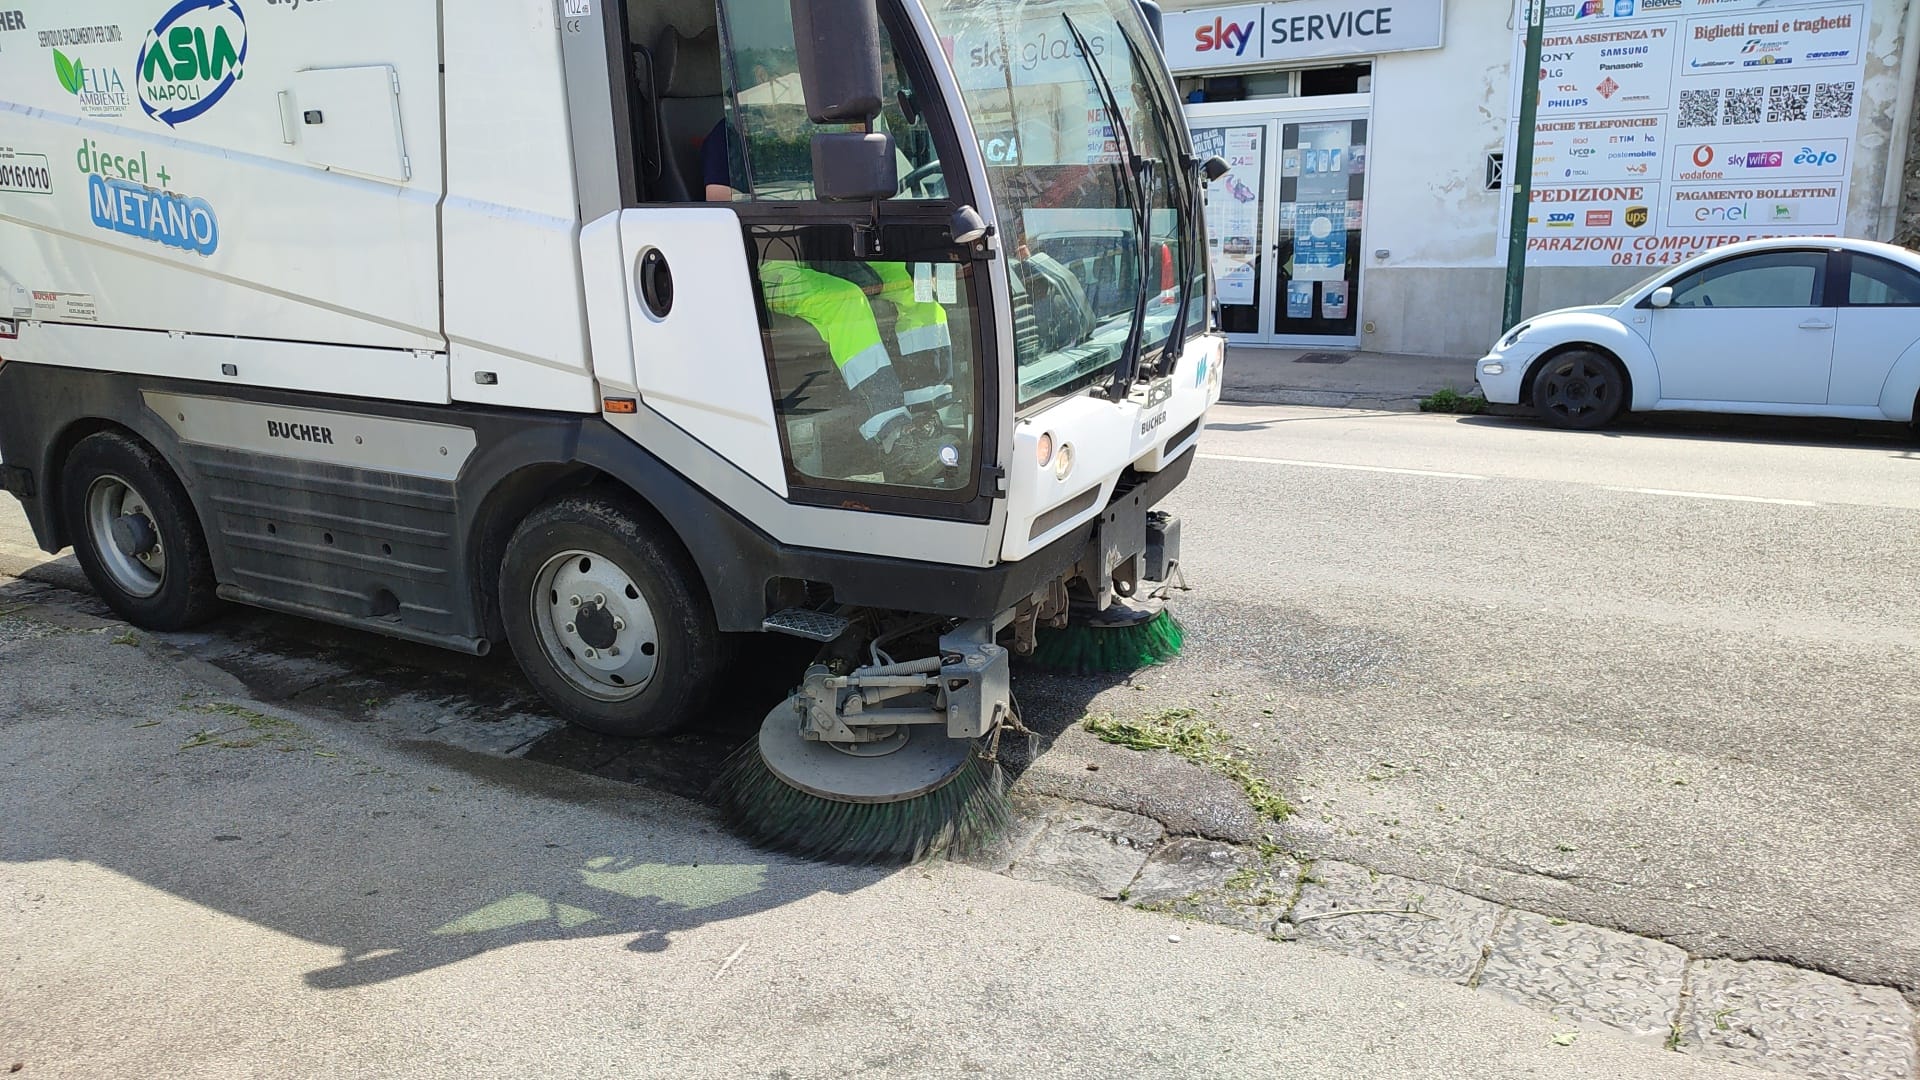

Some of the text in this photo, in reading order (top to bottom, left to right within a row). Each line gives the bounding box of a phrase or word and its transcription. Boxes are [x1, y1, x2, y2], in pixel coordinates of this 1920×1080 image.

[0, 10, 26, 31] HER
[1195, 8, 1392, 56] sky SERVICE
[1694, 14, 1852, 42] Biglietti treni e traghetti
[1523, 28, 1668, 49] NDITA ASSISTENZA TV
[143, 25, 243, 82] ASIA
[1541, 52, 1575, 63] ONY
[1600, 46, 1649, 57] SAMSUNG
[1600, 61, 1644, 71] Panasonic
[1549, 69, 1563, 78] LG
[148, 84, 200, 101] NAPOLI
[1558, 84, 1578, 92] TCL
[80, 93, 126, 105] AMBIENTE
[1548, 98, 1588, 108] PHILIPS
[1535, 118, 1658, 132] ARICHE TELEFONICHE
[1619, 135, 1635, 143] TIM
[1569, 148, 1590, 156] Lyca
[1608, 150, 1657, 160] postemobile
[1794, 149, 1837, 167] eolo
[77, 138, 147, 183] diesel
[1728, 153, 1767, 168] sky wifi
[1679, 170, 1723, 180] vodafone
[1529, 187, 1644, 203] PEDIZIONE
[1676, 188, 1837, 201] PAGAMENTO BOLLETTINI
[94, 183, 213, 245] METANO
[1547, 213, 1575, 222] SDA
[1626, 212, 1647, 225] ups
[1695, 202, 1748, 221] enel
[1527, 237, 1624, 251] PARAZIONI
[1611, 251, 1697, 266] 0816435
[1141, 411, 1167, 435] BUCHER
[267, 420, 334, 444] BUCHER
